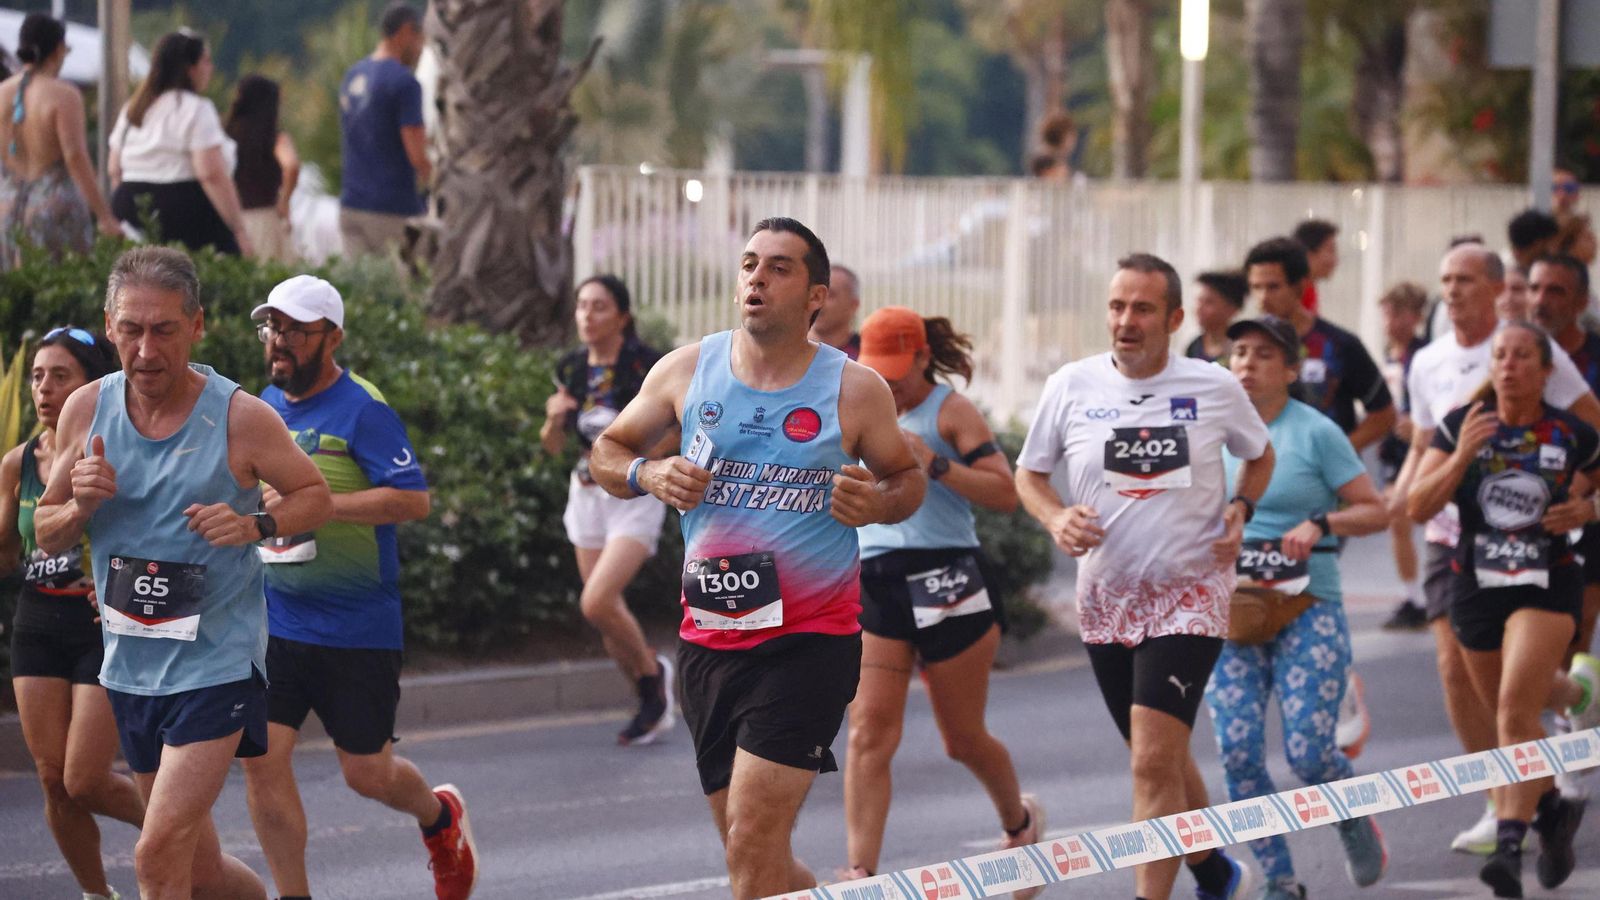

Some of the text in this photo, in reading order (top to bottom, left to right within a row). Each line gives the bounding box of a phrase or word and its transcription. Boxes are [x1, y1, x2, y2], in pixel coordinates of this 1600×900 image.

[1114, 438, 1178, 458] 2402
[711, 457, 834, 486] MEDIA MARATÓN
[704, 480, 828, 514] ESTEPONA
[1485, 541, 1539, 560] 2426
[25, 556, 69, 581] 2782
[134, 575, 169, 597] 65
[697, 570, 760, 593] 1300
